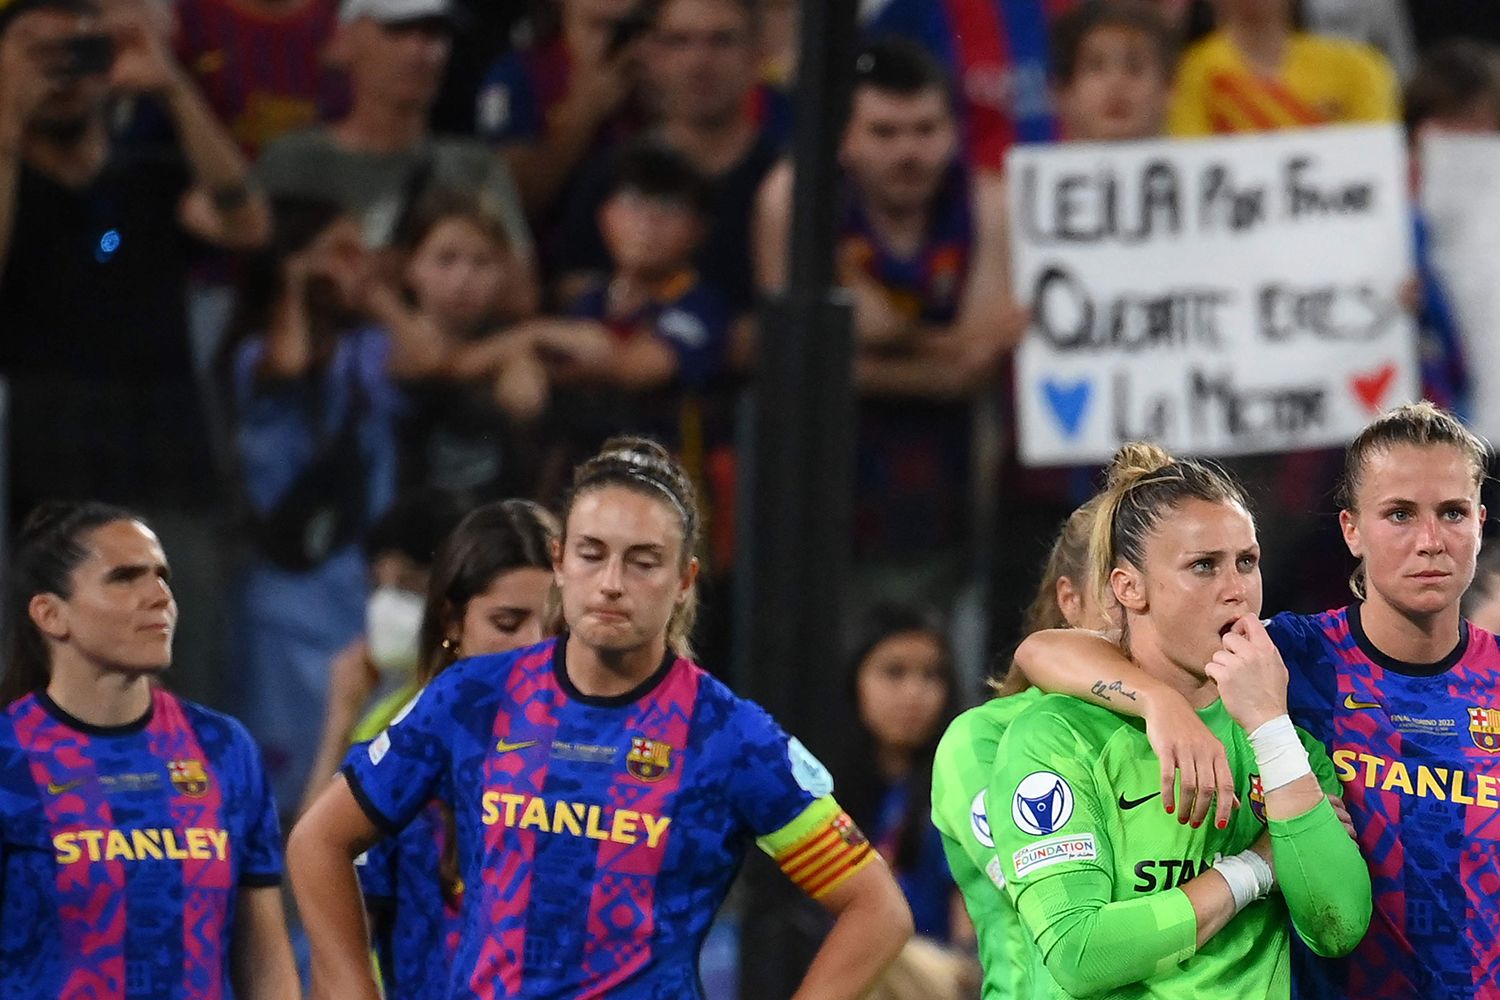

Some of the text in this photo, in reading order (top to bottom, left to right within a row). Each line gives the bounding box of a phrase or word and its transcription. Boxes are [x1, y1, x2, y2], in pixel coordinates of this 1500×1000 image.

[482, 792, 671, 848] STANLEY
[53, 829, 228, 864] STANLEY
[1016, 842, 1093, 869] FOUNDATION
[1133, 859, 1210, 893] STA
